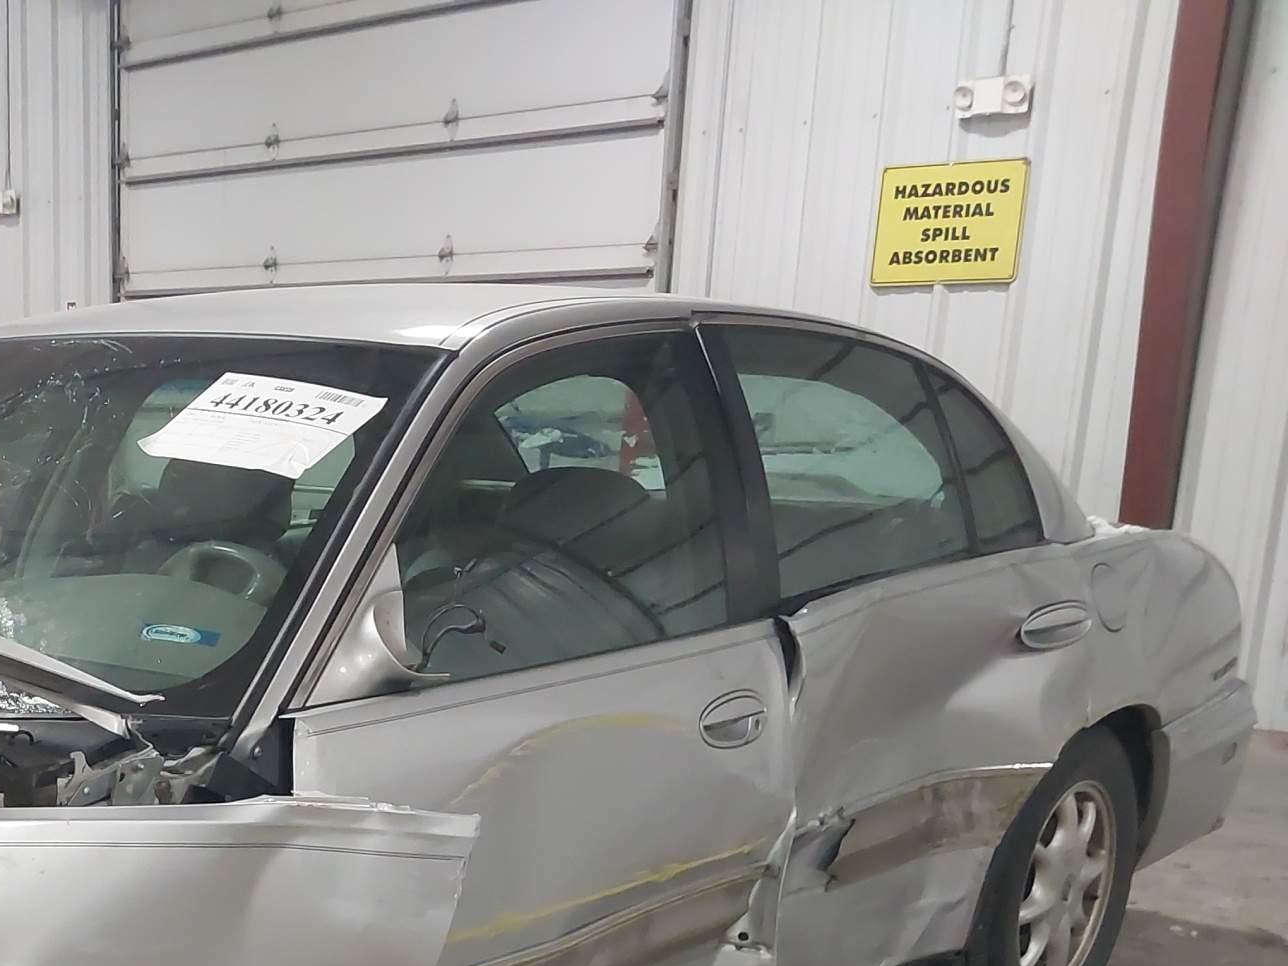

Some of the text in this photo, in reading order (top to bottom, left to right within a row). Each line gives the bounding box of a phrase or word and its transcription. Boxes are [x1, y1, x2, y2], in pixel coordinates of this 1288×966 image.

[893, 179, 1011, 200] HAZARDOUS
[902, 202, 995, 221] MATERIAL
[920, 226, 971, 242] SPILL
[888, 247, 999, 266] ABSORBENT
[210, 392, 345, 425] 44180324
